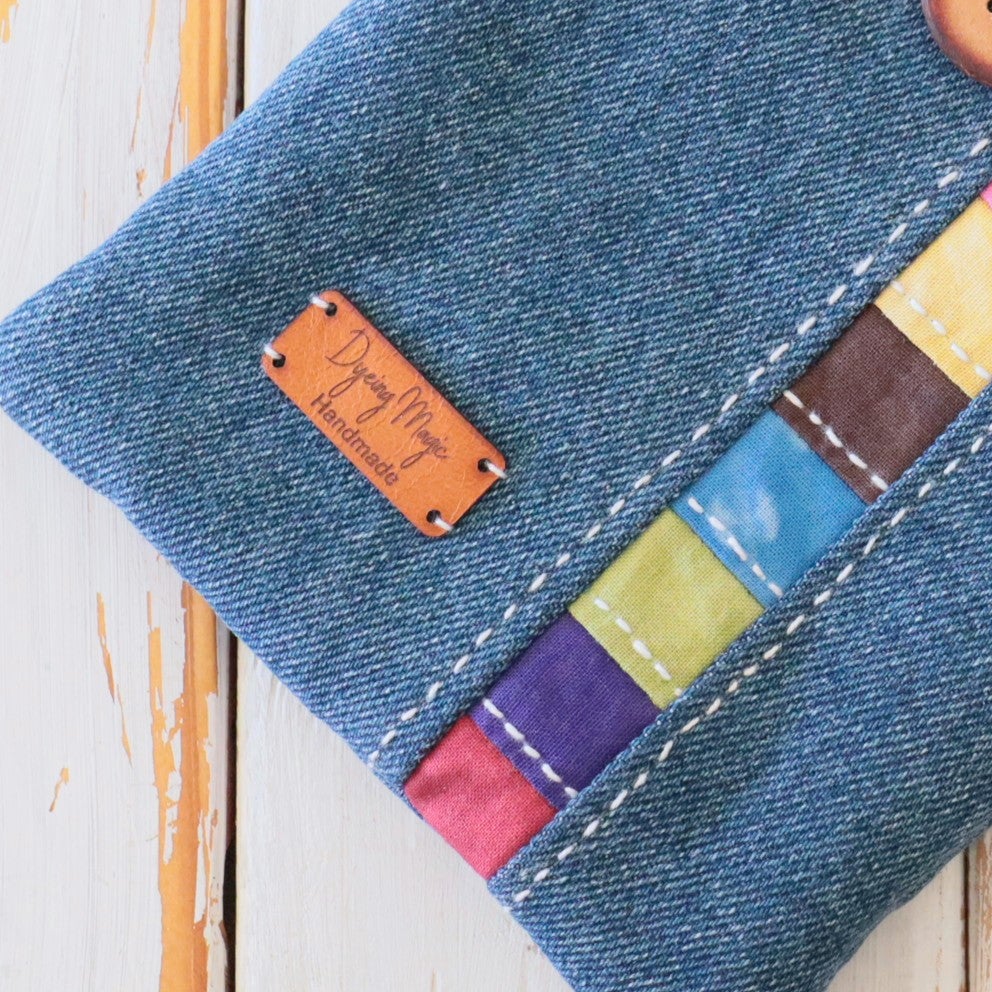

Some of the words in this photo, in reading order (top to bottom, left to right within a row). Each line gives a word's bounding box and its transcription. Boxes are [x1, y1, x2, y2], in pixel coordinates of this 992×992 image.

[310, 392, 399, 486] Handmade
[325, 328, 396, 424] Dyeing
[390, 386, 450, 470] Magic
